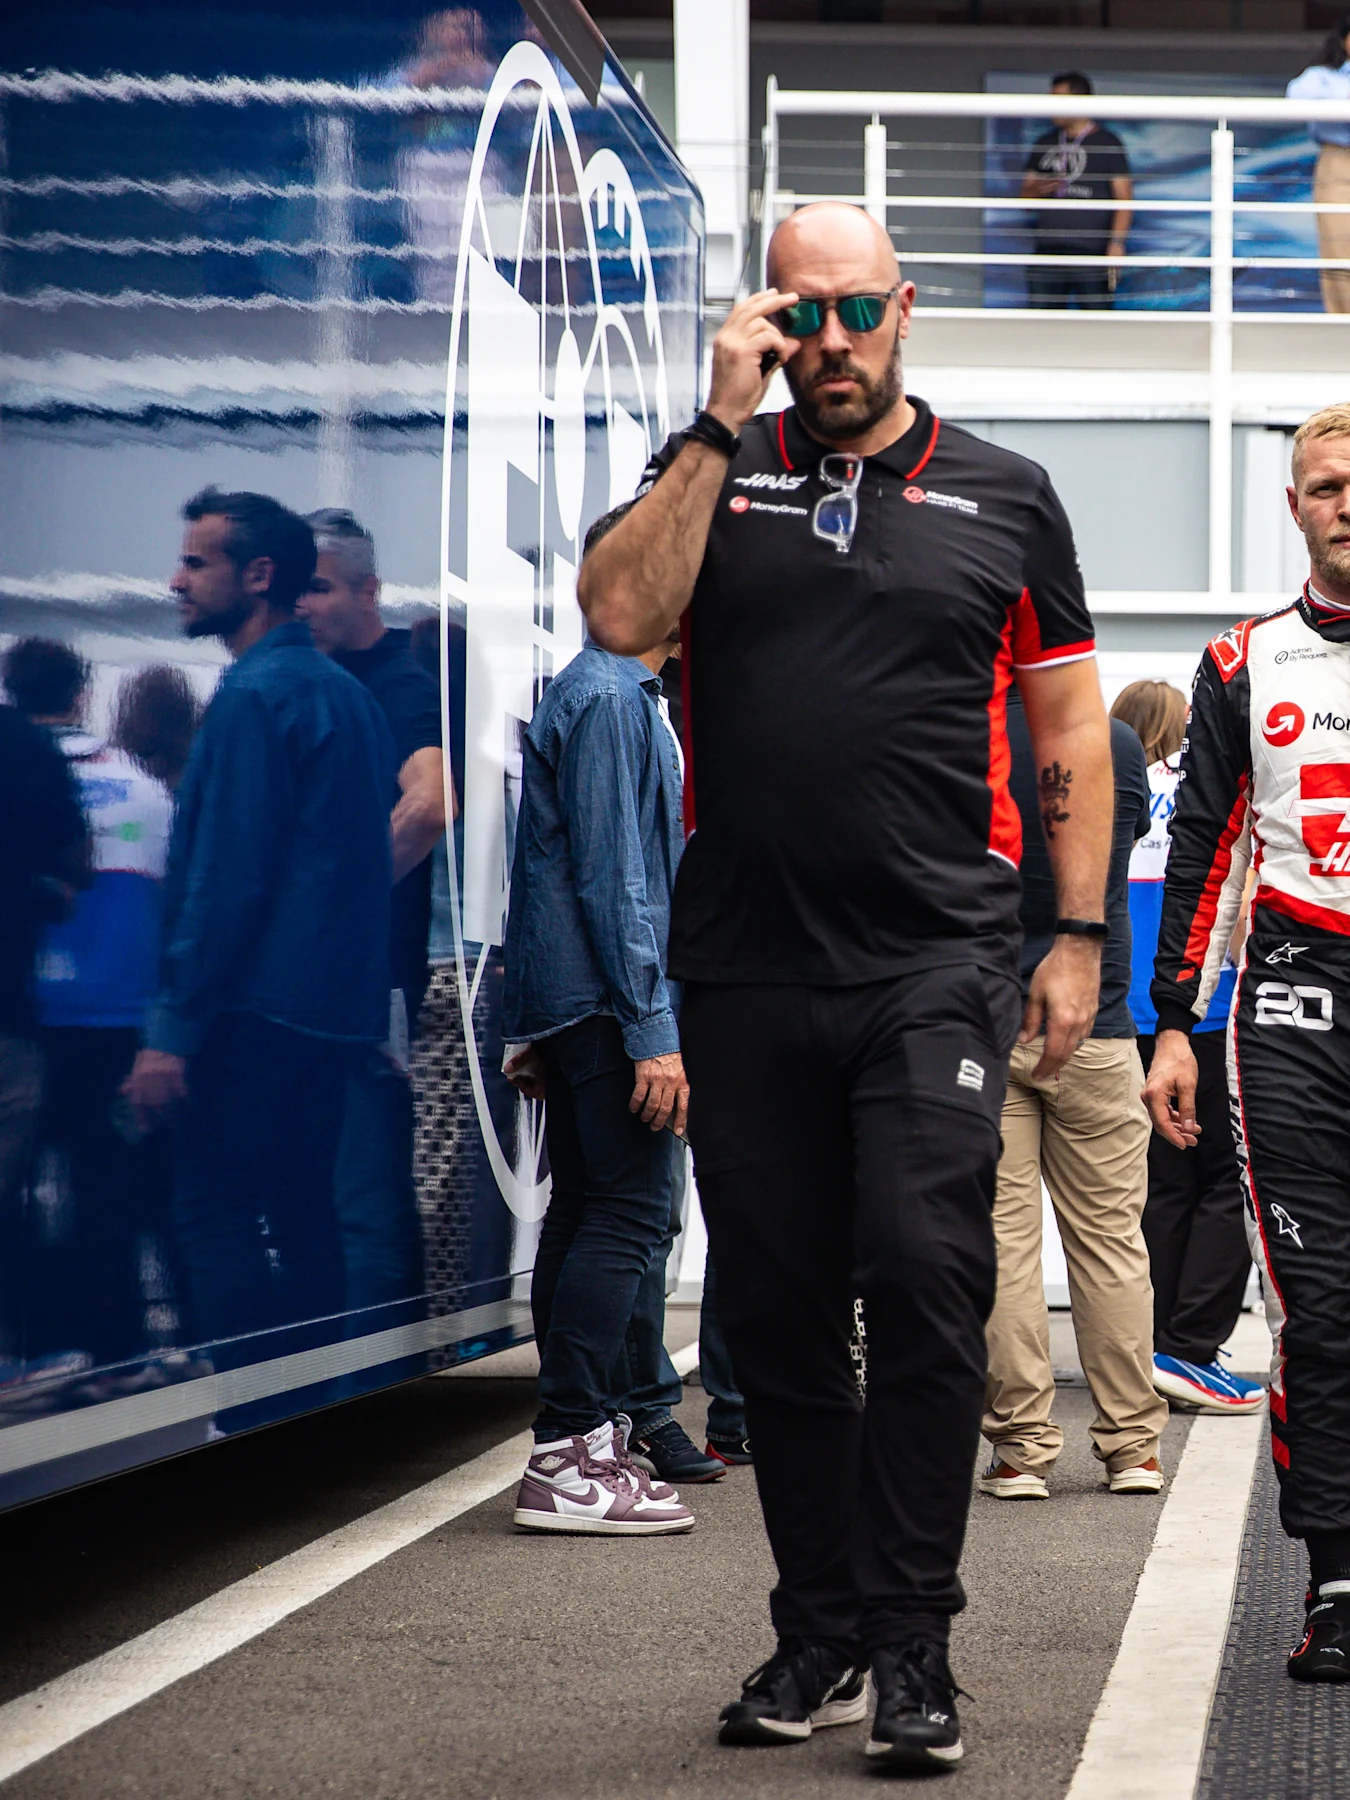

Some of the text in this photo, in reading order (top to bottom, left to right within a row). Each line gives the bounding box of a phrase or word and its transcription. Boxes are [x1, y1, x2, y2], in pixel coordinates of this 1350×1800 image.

[734, 473, 808, 490] HAAS
[750, 501, 808, 516] MoneyGram
[1254, 981, 1335, 1032] 20
